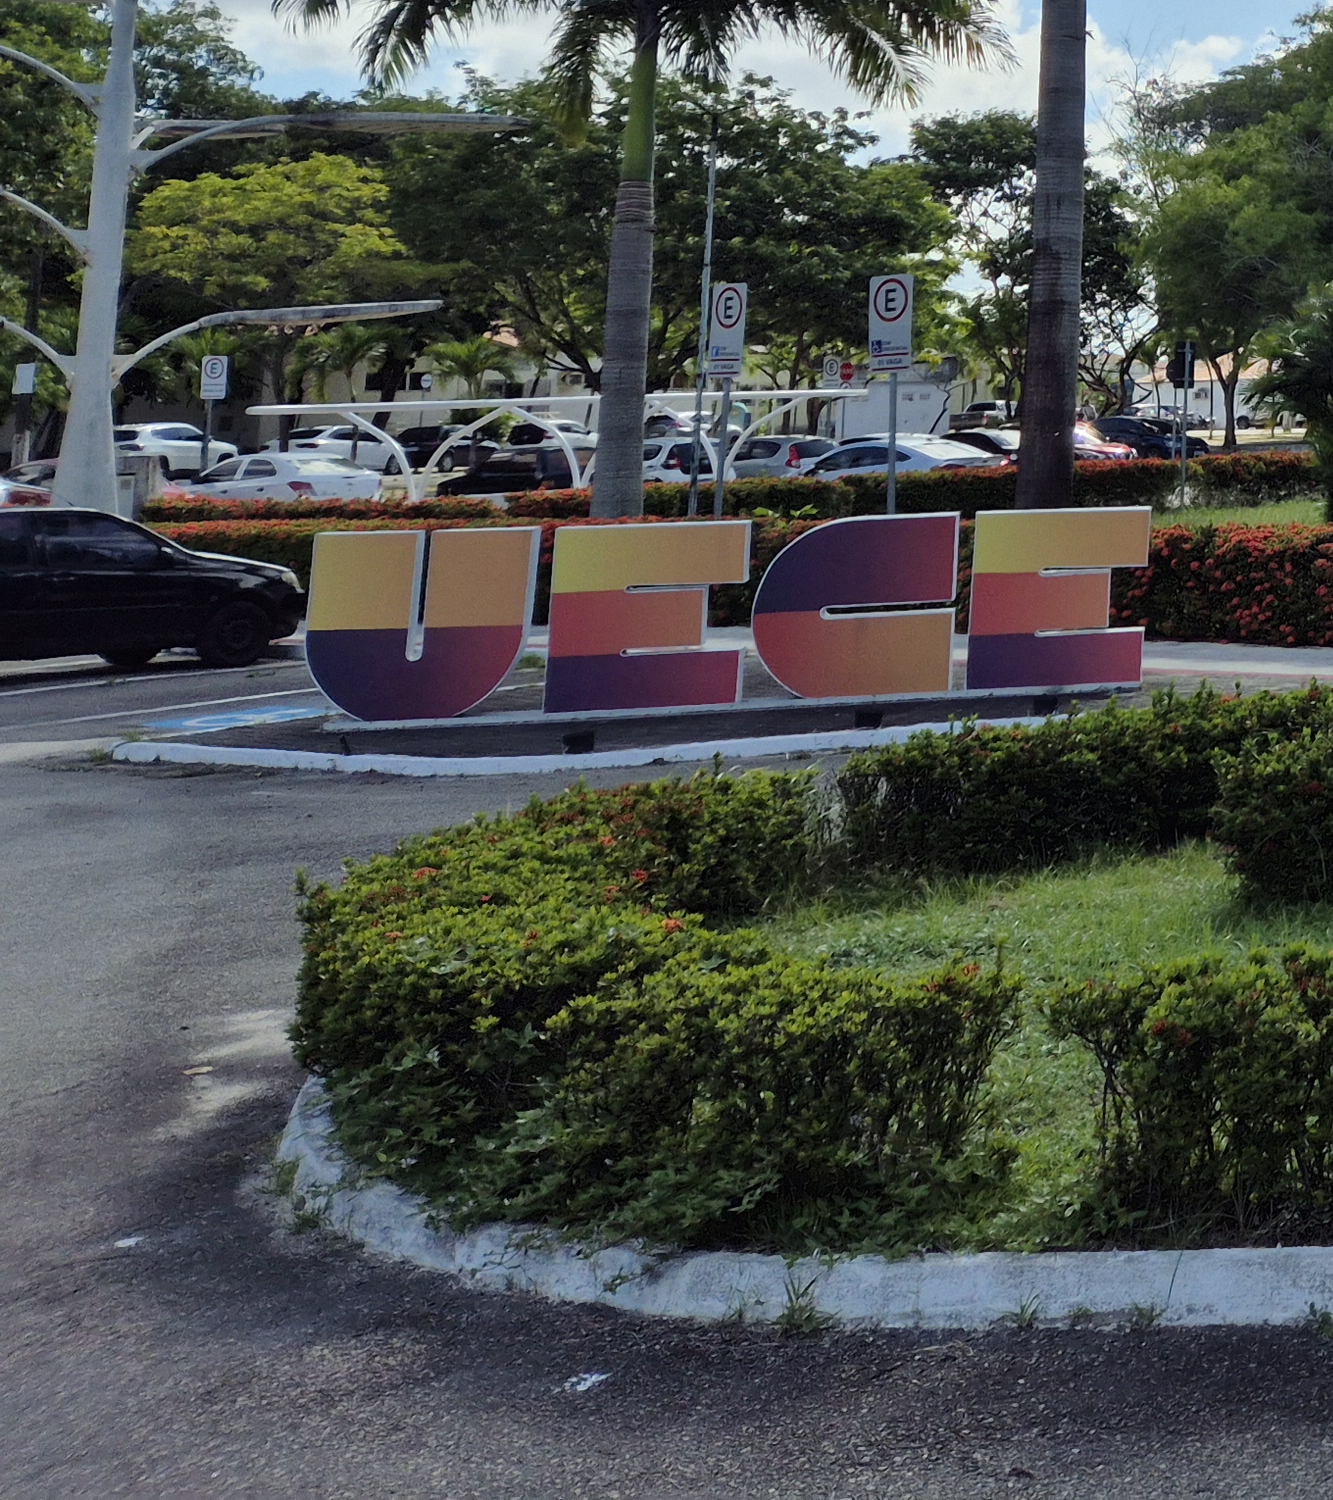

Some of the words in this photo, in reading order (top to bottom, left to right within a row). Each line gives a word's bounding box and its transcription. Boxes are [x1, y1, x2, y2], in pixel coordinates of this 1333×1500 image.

[724, 296, 734, 320] E
[884, 288, 897, 312] E
[210, 362, 218, 375] E
[304, 504, 1153, 724] UECE
